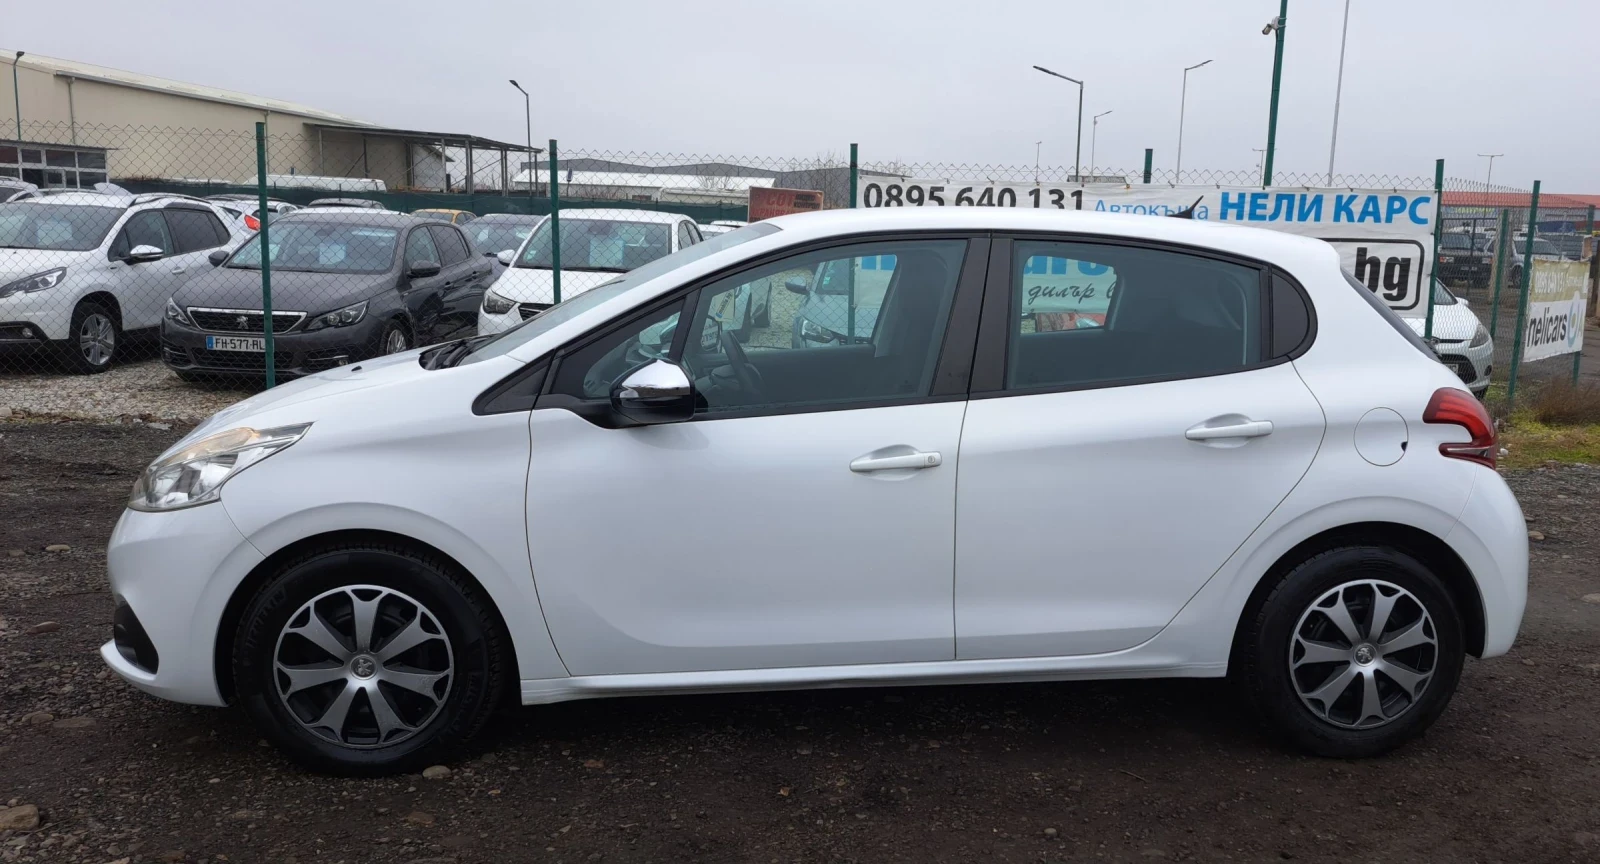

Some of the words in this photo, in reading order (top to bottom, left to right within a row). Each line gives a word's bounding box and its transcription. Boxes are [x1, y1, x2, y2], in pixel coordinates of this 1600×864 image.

[863, 183, 945, 207] 0895
[955, 186, 1017, 207] 640
[1028, 188, 1084, 211] 131
[1219, 191, 1324, 222] НЕЛИ
[1333, 194, 1432, 225] КАРС
[1527, 307, 1567, 347] nelicars
